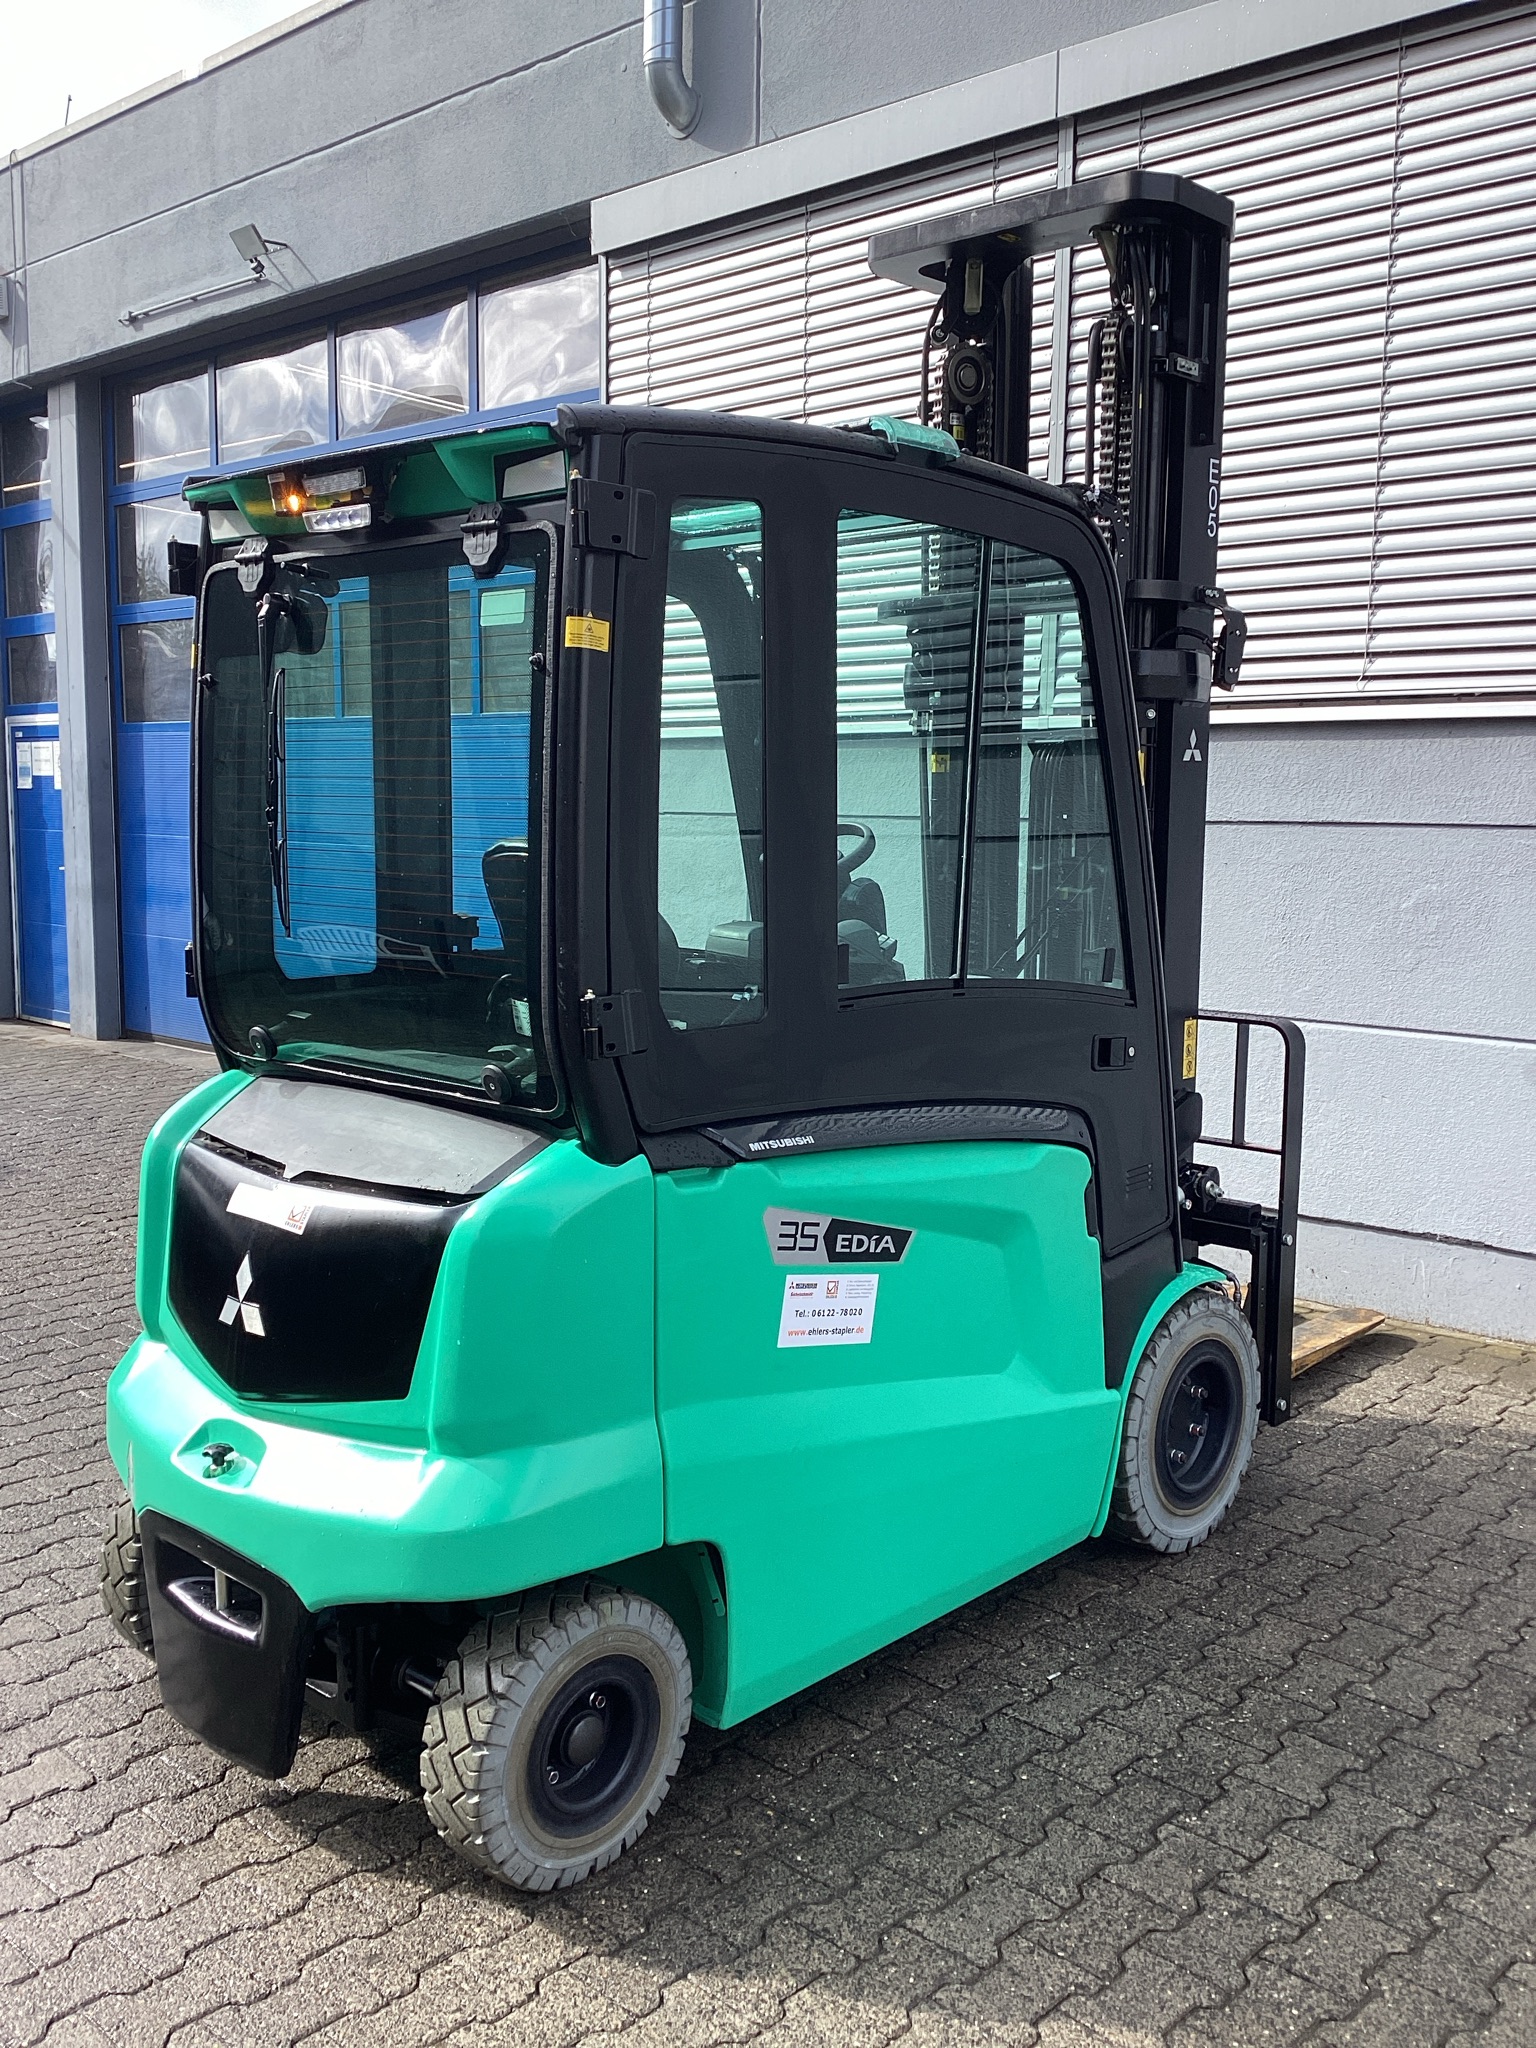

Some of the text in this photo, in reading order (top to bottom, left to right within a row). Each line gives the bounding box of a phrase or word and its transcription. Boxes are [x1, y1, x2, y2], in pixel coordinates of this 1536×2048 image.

[748, 1135, 815, 1152] MITSUBISHI
[777, 1221, 820, 1251] 35
[787, 1325, 865, 1337] www.ehlers-stapler.de
